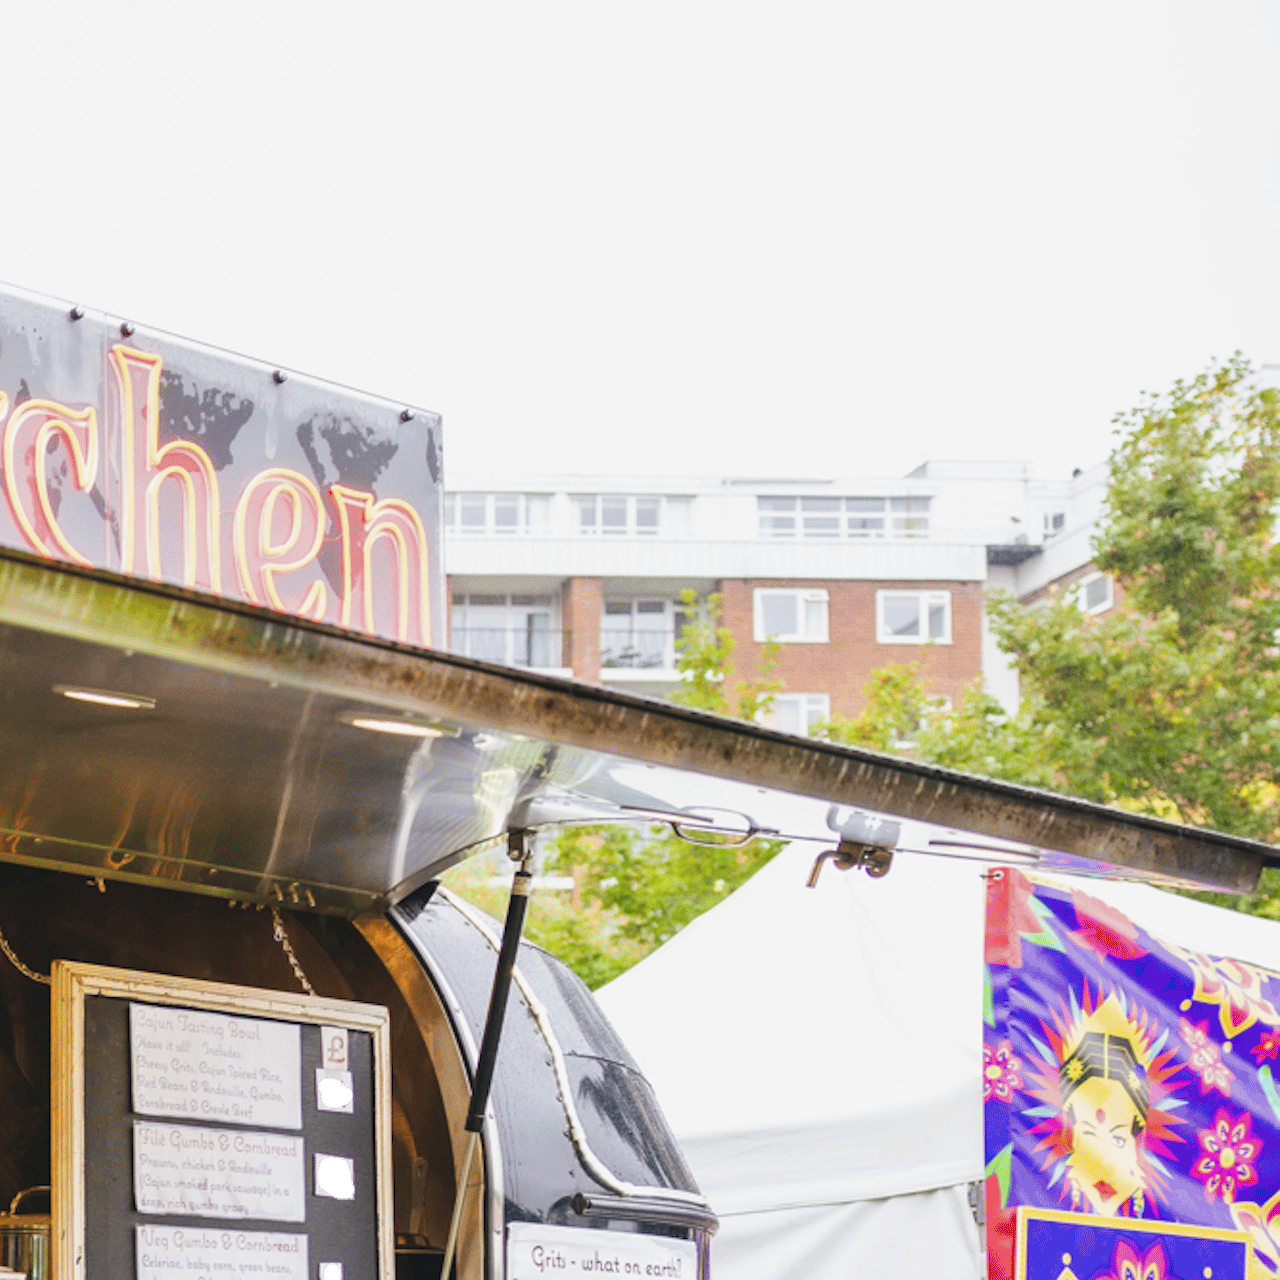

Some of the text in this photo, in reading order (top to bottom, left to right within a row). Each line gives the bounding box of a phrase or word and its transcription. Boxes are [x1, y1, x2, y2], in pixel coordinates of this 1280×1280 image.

[135, 1010, 261, 1040] Cajun Tasting Bowl
[327, 1037, 345, 1063] £
[170, 1131, 214, 1151] Gumbo
[219, 1136, 229, 1150] &
[234, 1135, 298, 1157] Cornbread
[141, 1229, 298, 1253] Veg Gumbo & Cornbread
[531, 1245, 566, 1273] Grits
[582, 1252, 620, 1273] what
[625, 1260, 641, 1275] on
[646, 1258, 681, 1278] earth?
